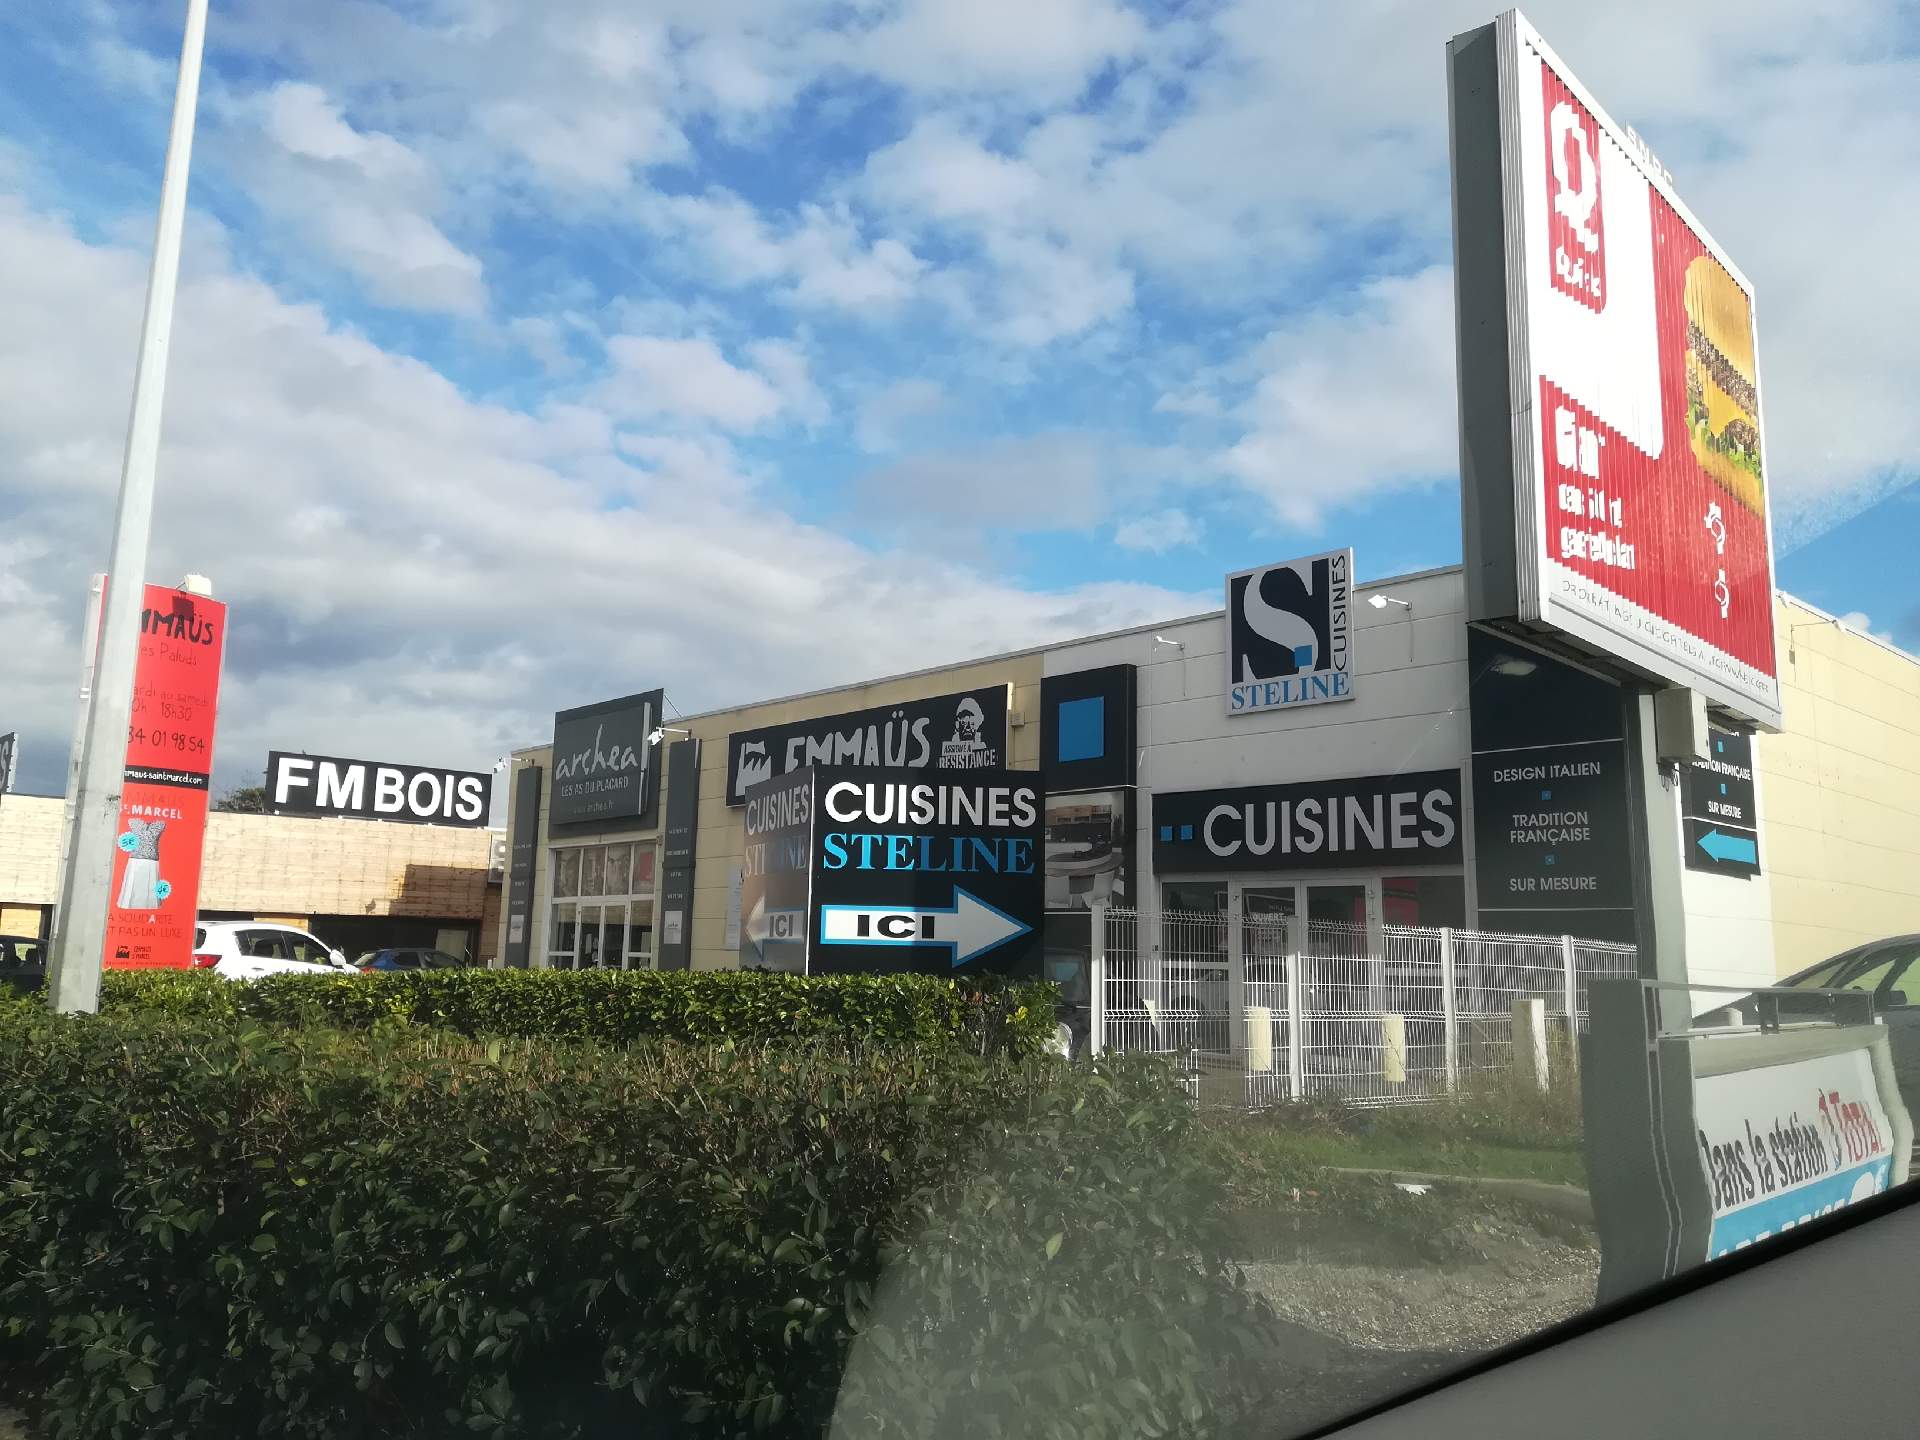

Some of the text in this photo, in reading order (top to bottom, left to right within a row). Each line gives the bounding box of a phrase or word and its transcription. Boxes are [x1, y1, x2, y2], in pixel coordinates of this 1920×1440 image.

[142, 608, 214, 646] MAÜS
[1331, 554, 1347, 672] CUISINES
[140, 645, 155, 657] es
[133, 680, 156, 697] ardi
[1231, 671, 1351, 711] STELINE
[556, 723, 639, 781] archea
[785, 710, 930, 774] EMMAÜS
[1493, 761, 1601, 783] DESIGN ITALIEN
[746, 783, 810, 836] CUISINES
[824, 781, 1037, 828] CUISINES
[1512, 811, 1589, 828] TRADITION
[1708, 800, 1720, 815] SUR
[1203, 788, 1456, 858] CUISINES
[1510, 828, 1592, 846] FRANÇAISE
[823, 832, 1037, 875] STELINE
[1509, 876, 1598, 892] SUR MESURE
[769, 914, 795, 938] ICI
[857, 914, 936, 939] ICI
